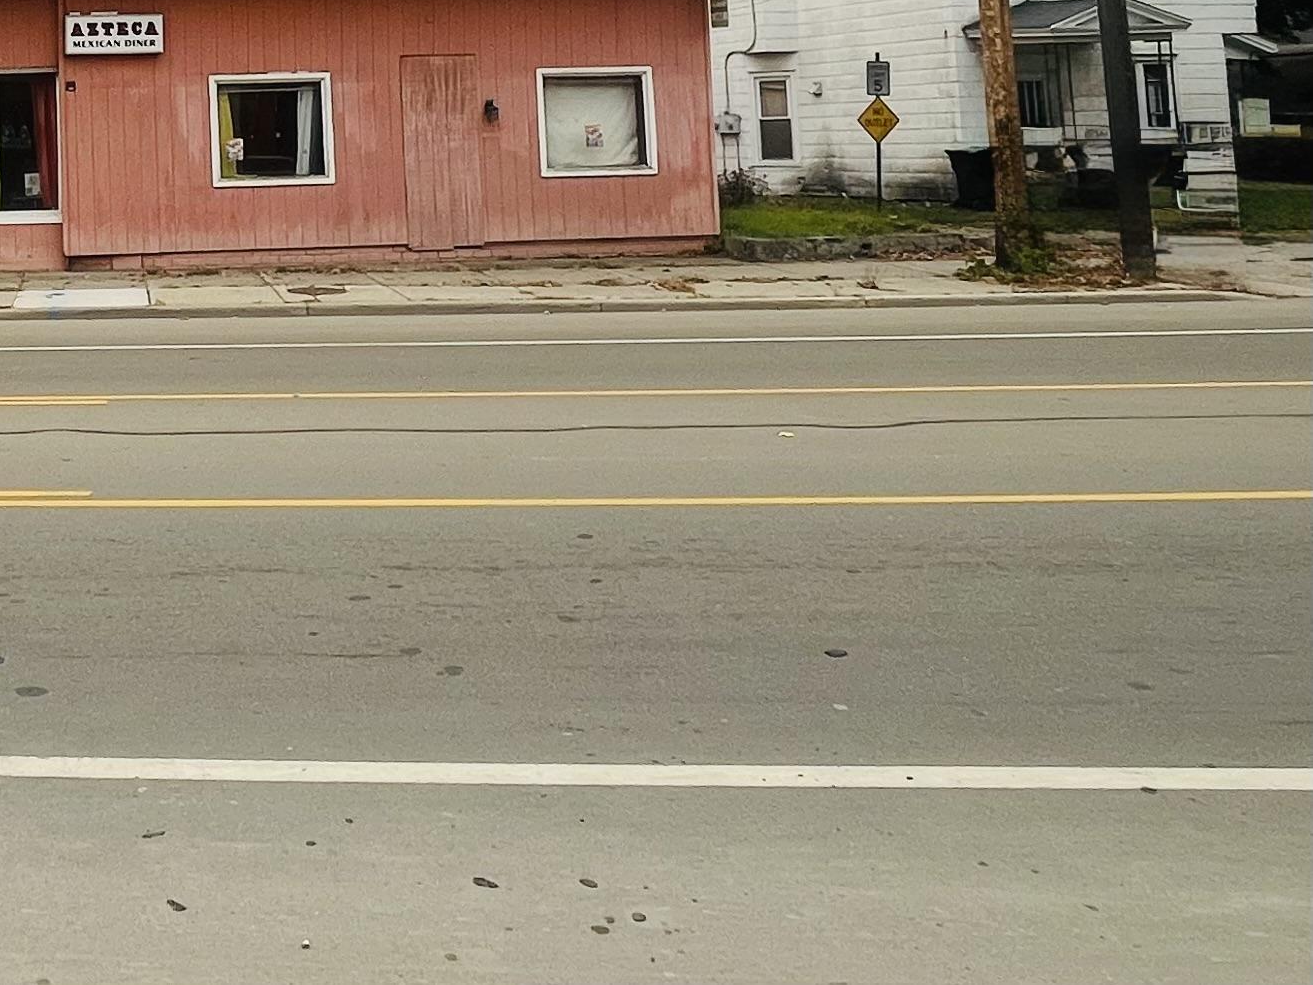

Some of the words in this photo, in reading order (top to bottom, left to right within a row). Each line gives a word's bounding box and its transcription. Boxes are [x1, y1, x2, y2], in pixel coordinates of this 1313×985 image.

[70, 21, 159, 37] AZTECA
[72, 39, 121, 48] MEXICAN
[124, 39, 156, 47] DINER
